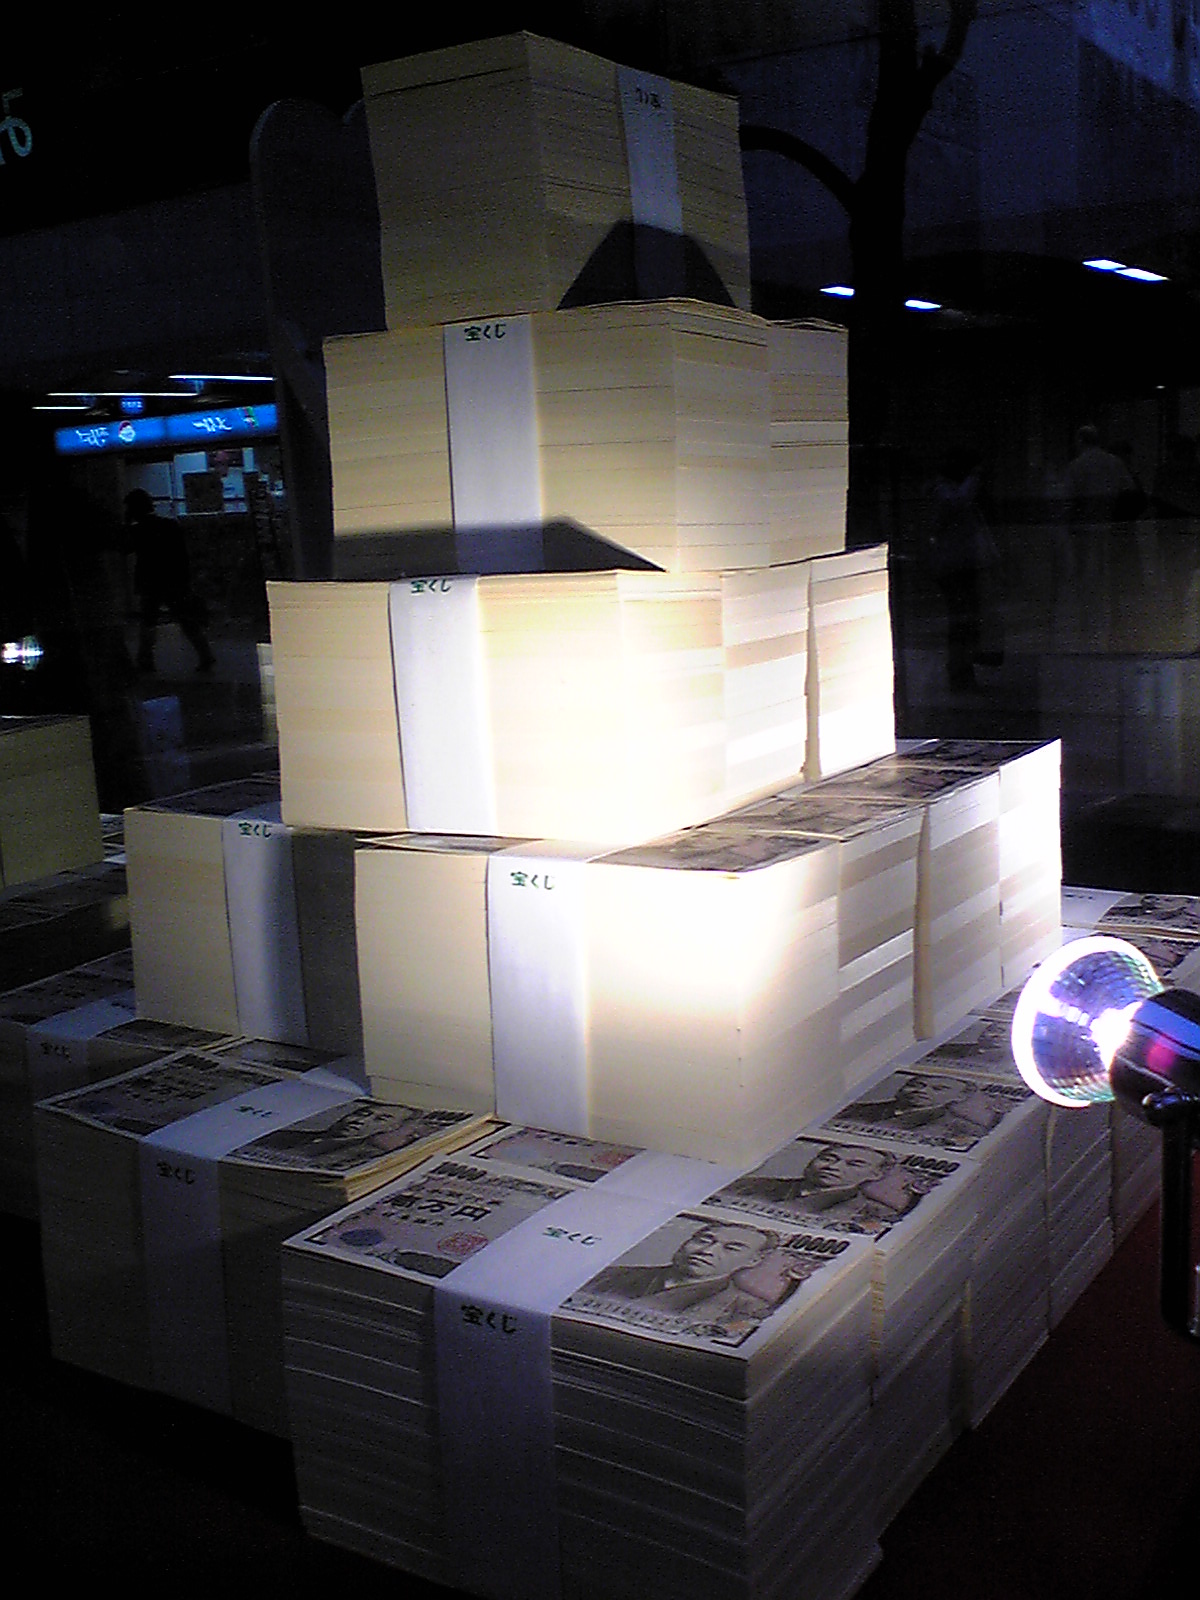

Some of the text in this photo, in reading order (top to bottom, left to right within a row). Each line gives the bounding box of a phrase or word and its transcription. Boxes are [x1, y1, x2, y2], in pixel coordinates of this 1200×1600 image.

[464, 324, 507, 341] 宝くじ
[411, 579, 451, 593] 宝くじ
[238, 822, 272, 838] 宝くじ
[510, 871, 555, 890] 宝くじ
[157, 1161, 196, 1184] 宝くじ
[900, 1154, 960, 1173] 10000
[542, 1227, 602, 1245] 宝くじ
[782, 1234, 850, 1254] 10000
[461, 1305, 517, 1333] 宝くじ
